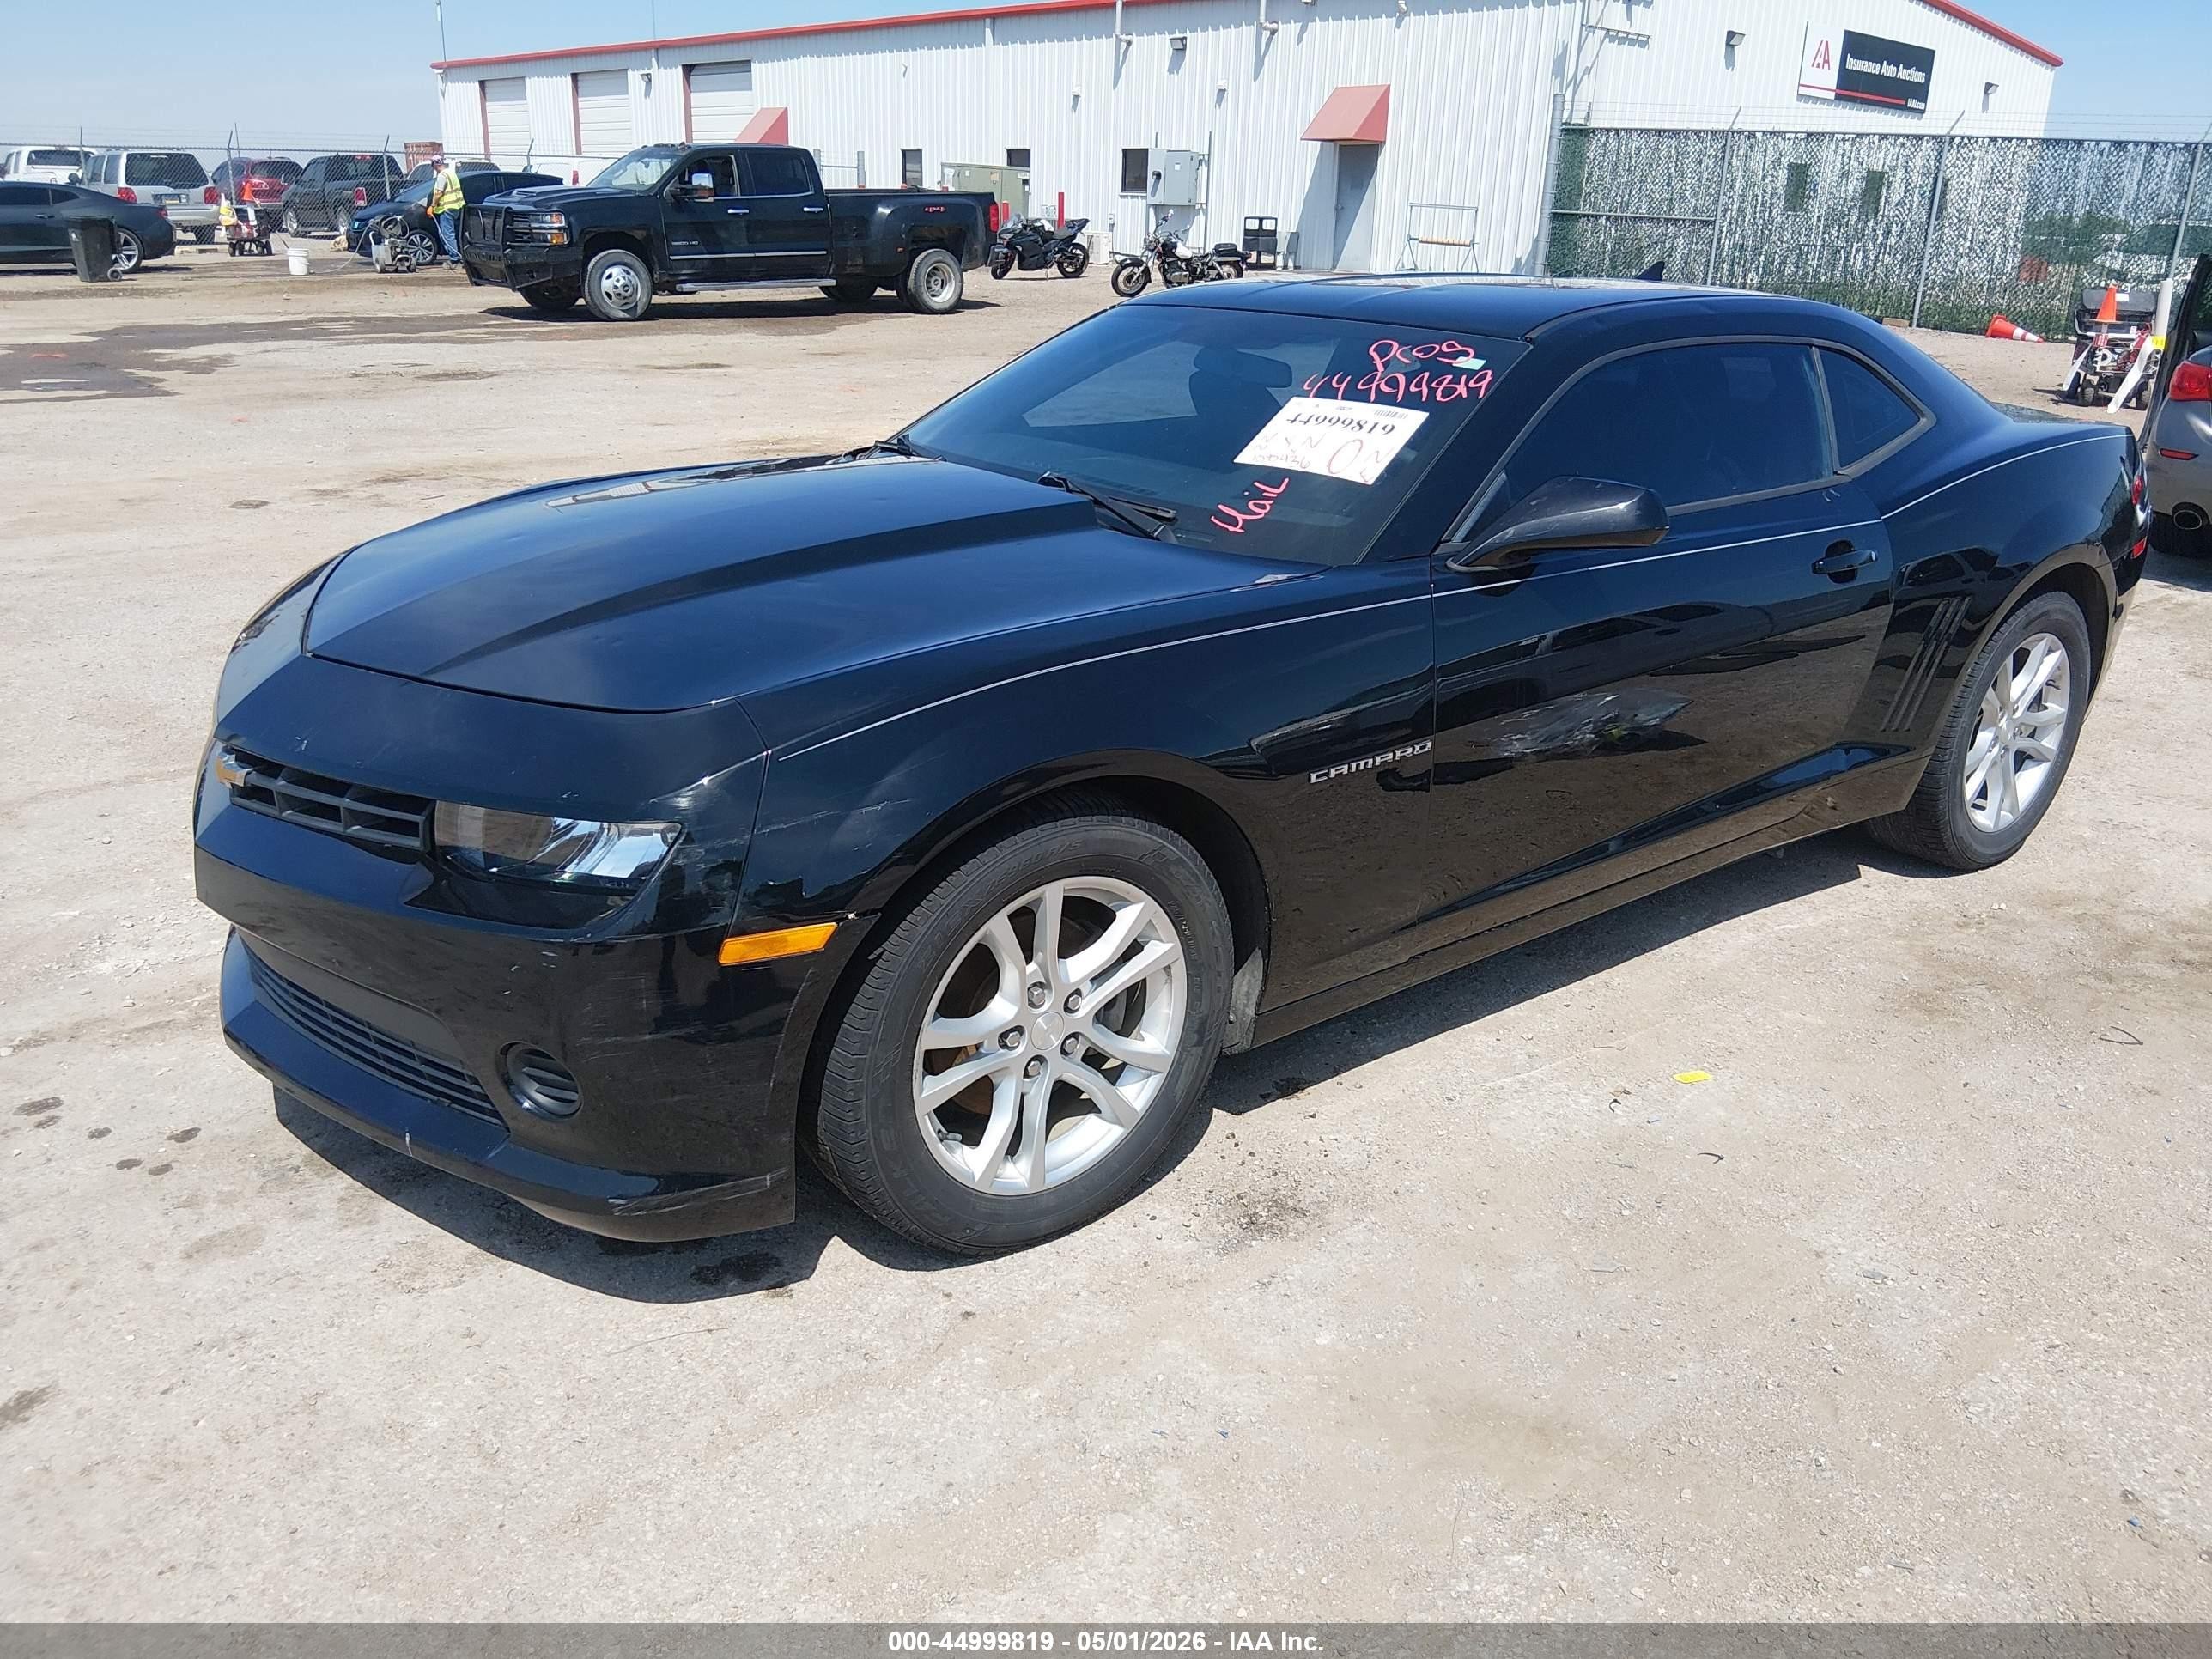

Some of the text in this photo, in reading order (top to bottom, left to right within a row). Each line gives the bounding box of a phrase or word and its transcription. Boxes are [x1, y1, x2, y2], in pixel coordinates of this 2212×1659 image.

[1845, 52, 1926, 84] Insurance Auto Auctions
[1286, 412, 1396, 436] 44999819
[1309, 739, 1433, 784] CAMARO
